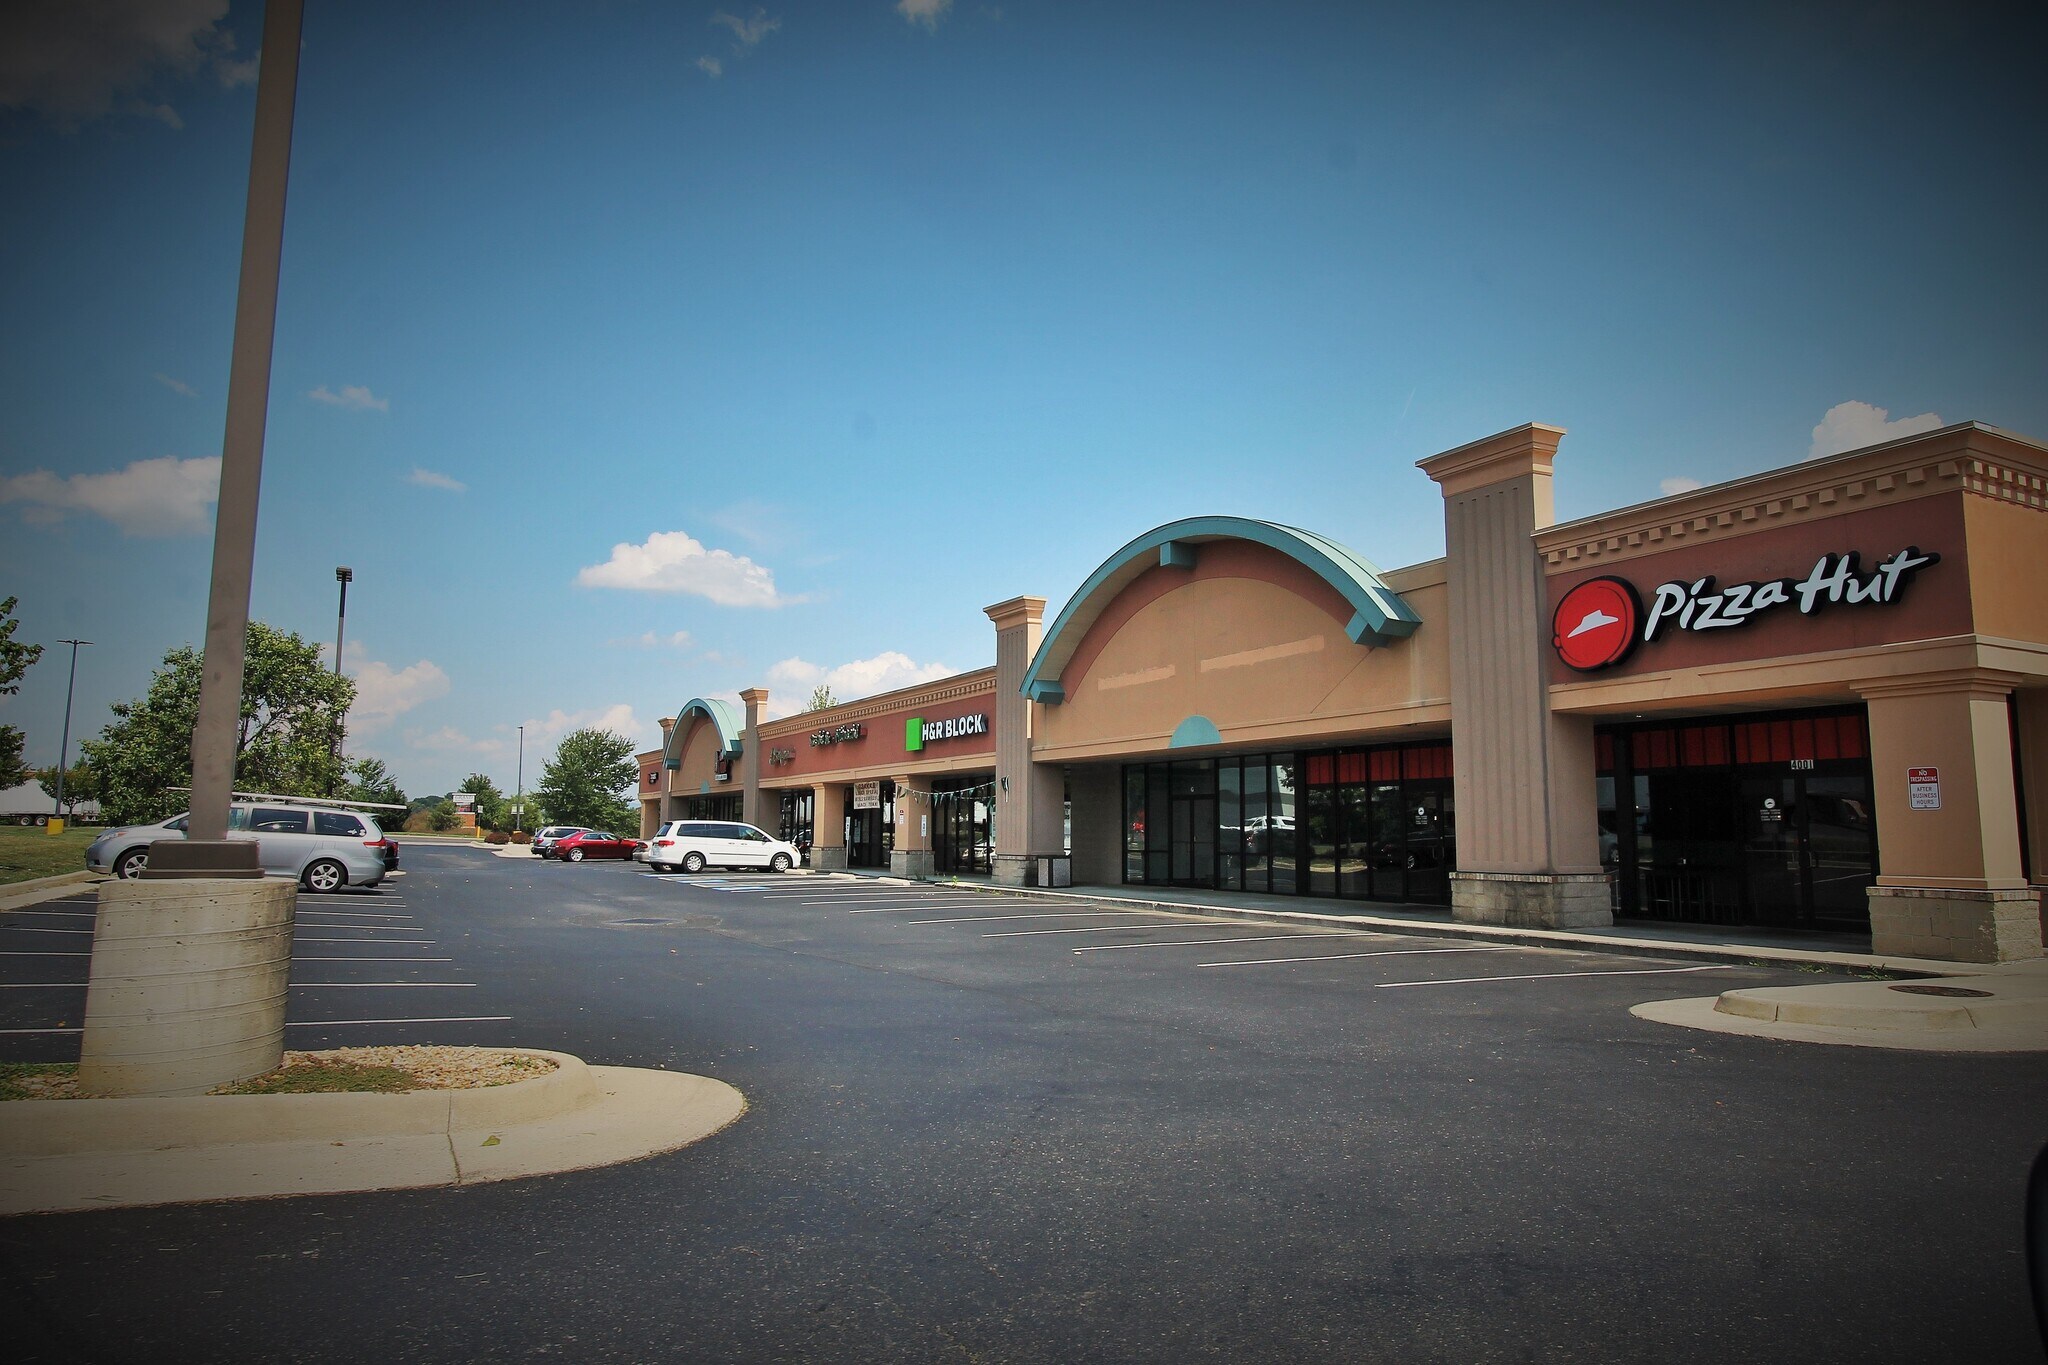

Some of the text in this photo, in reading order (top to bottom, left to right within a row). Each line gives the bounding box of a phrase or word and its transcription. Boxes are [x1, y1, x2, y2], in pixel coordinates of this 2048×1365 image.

[1643, 549, 1930, 642] Pizza Hut
[922, 713, 983, 741] H&R BLOCK
[1791, 759, 1814, 769] 4001
